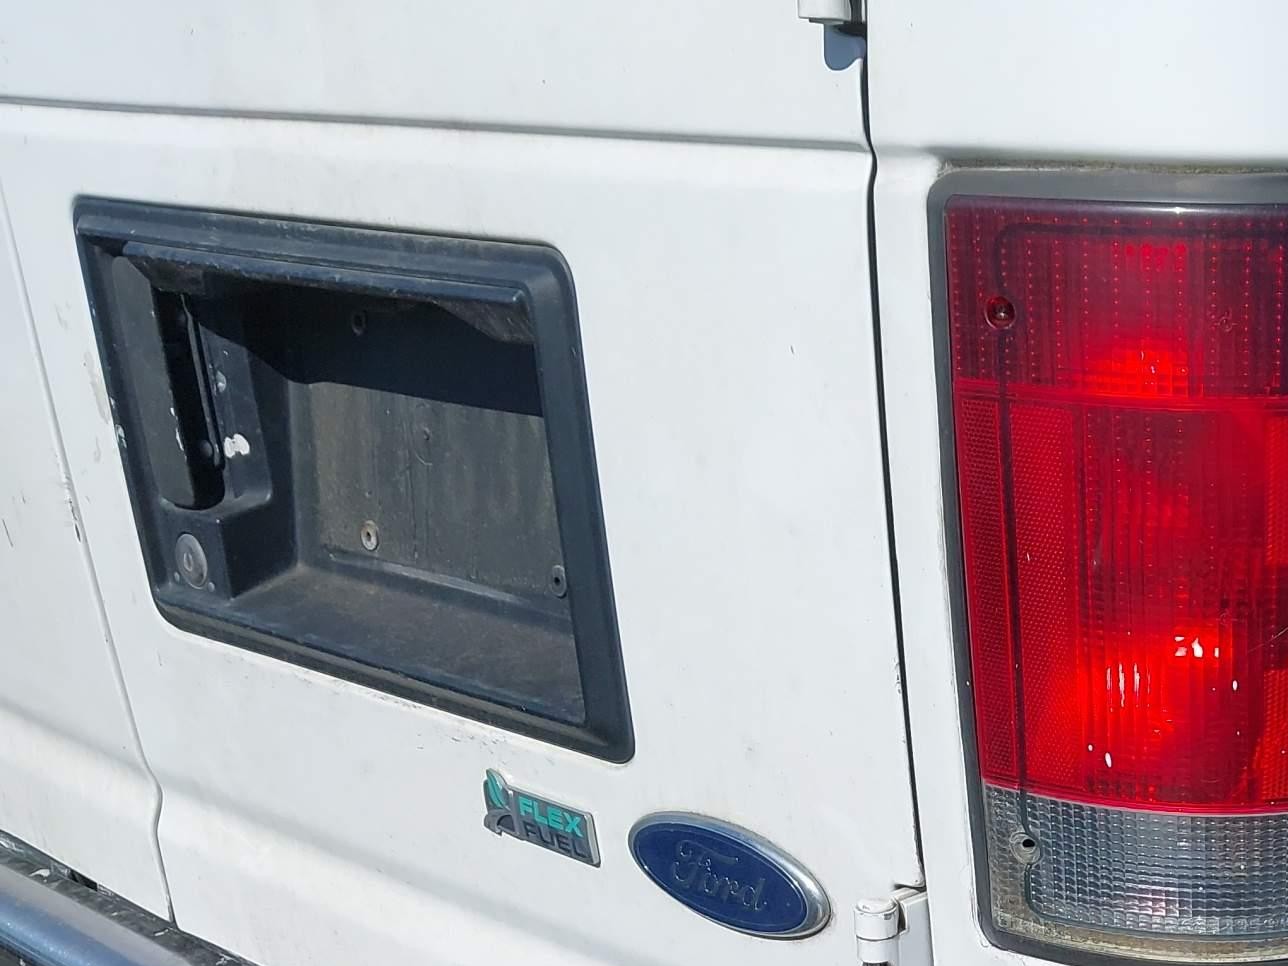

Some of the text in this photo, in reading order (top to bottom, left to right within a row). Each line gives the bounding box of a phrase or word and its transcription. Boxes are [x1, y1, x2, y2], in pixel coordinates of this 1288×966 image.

[518, 796, 583, 837] FLEX
[522, 821, 593, 859] FUEL
[673, 839, 768, 911] Ford
